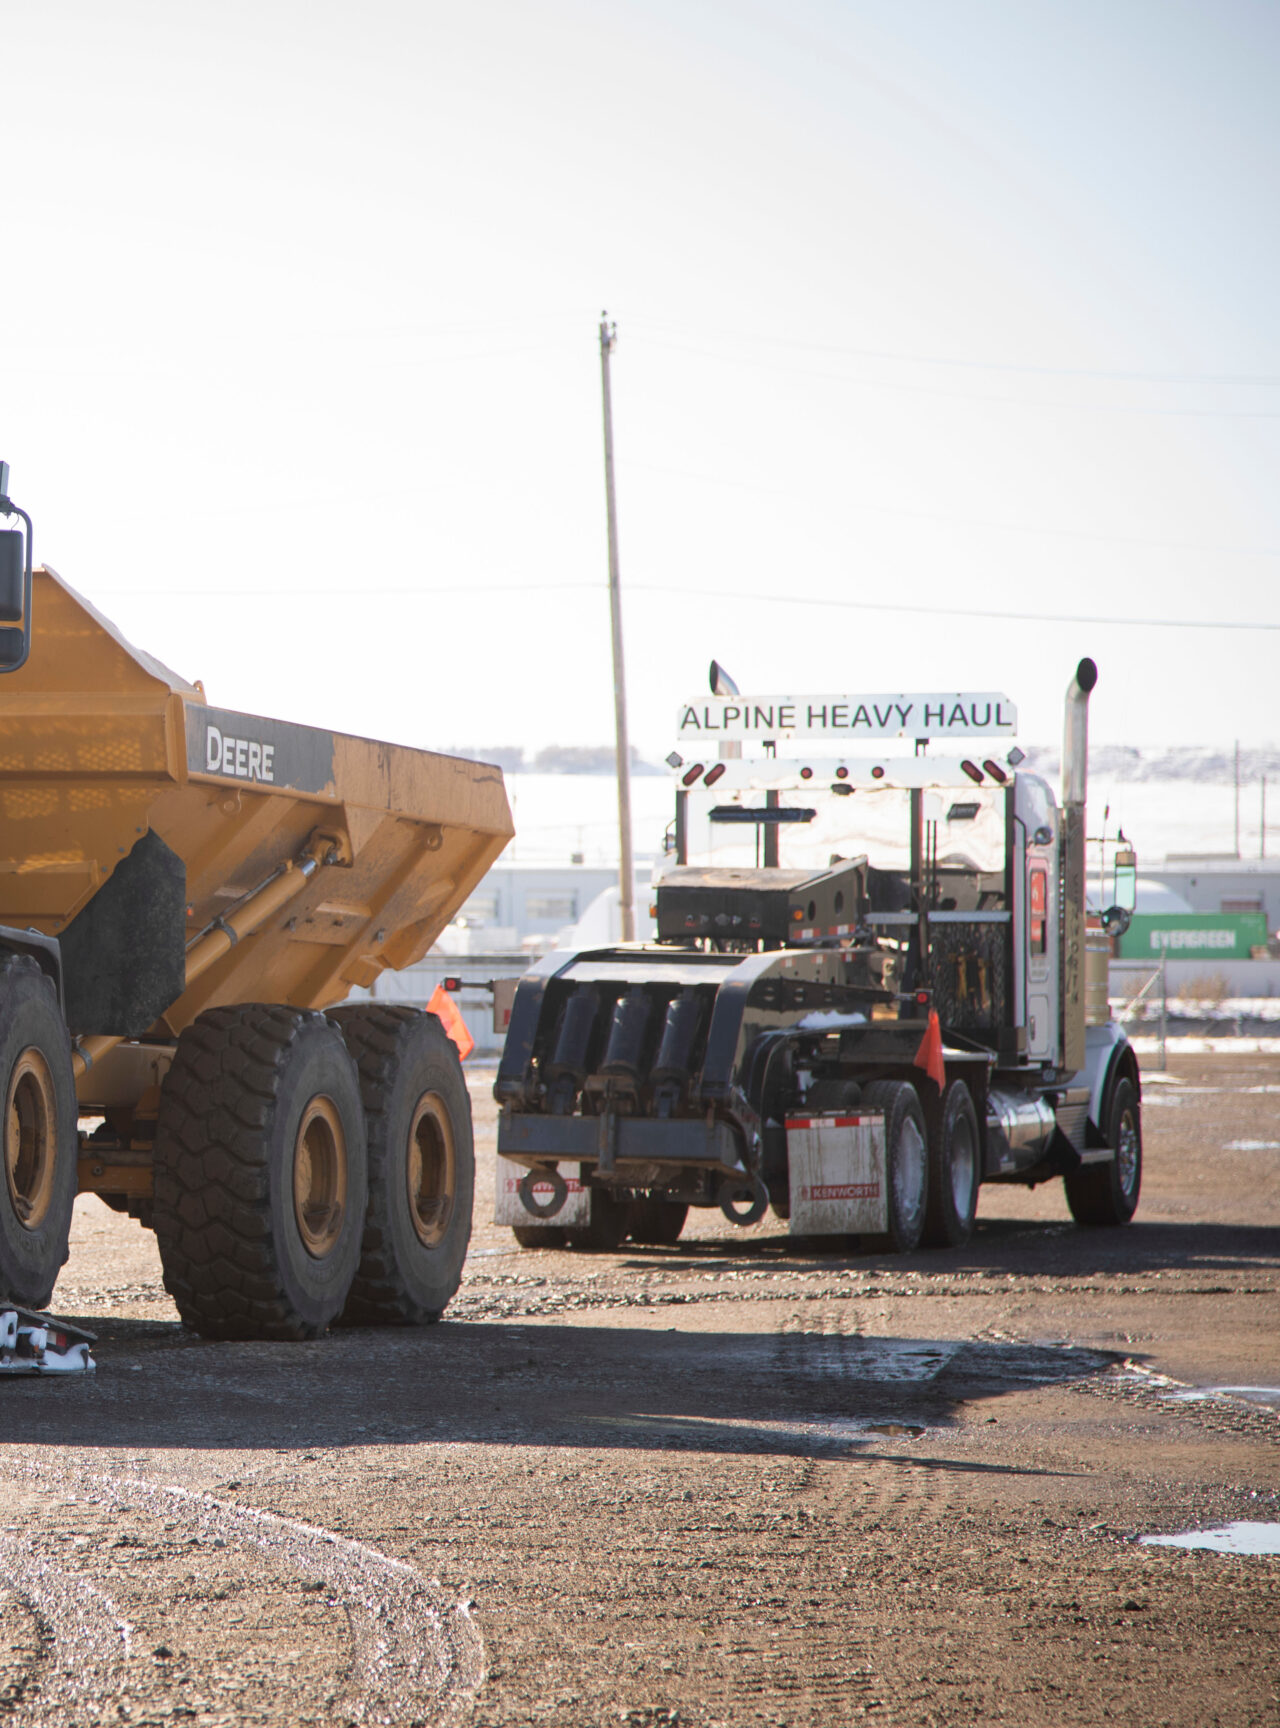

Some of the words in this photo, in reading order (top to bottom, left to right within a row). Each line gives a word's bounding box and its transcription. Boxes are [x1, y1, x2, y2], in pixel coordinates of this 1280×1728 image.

[680, 704, 796, 730] ALPINE
[807, 703, 914, 729] HEAVY
[924, 702, 1013, 728] HAUL
[206, 725, 275, 782] DEERE
[1149, 929, 1237, 950] EVERGREEN
[813, 1185, 877, 1198] KENWORTH
